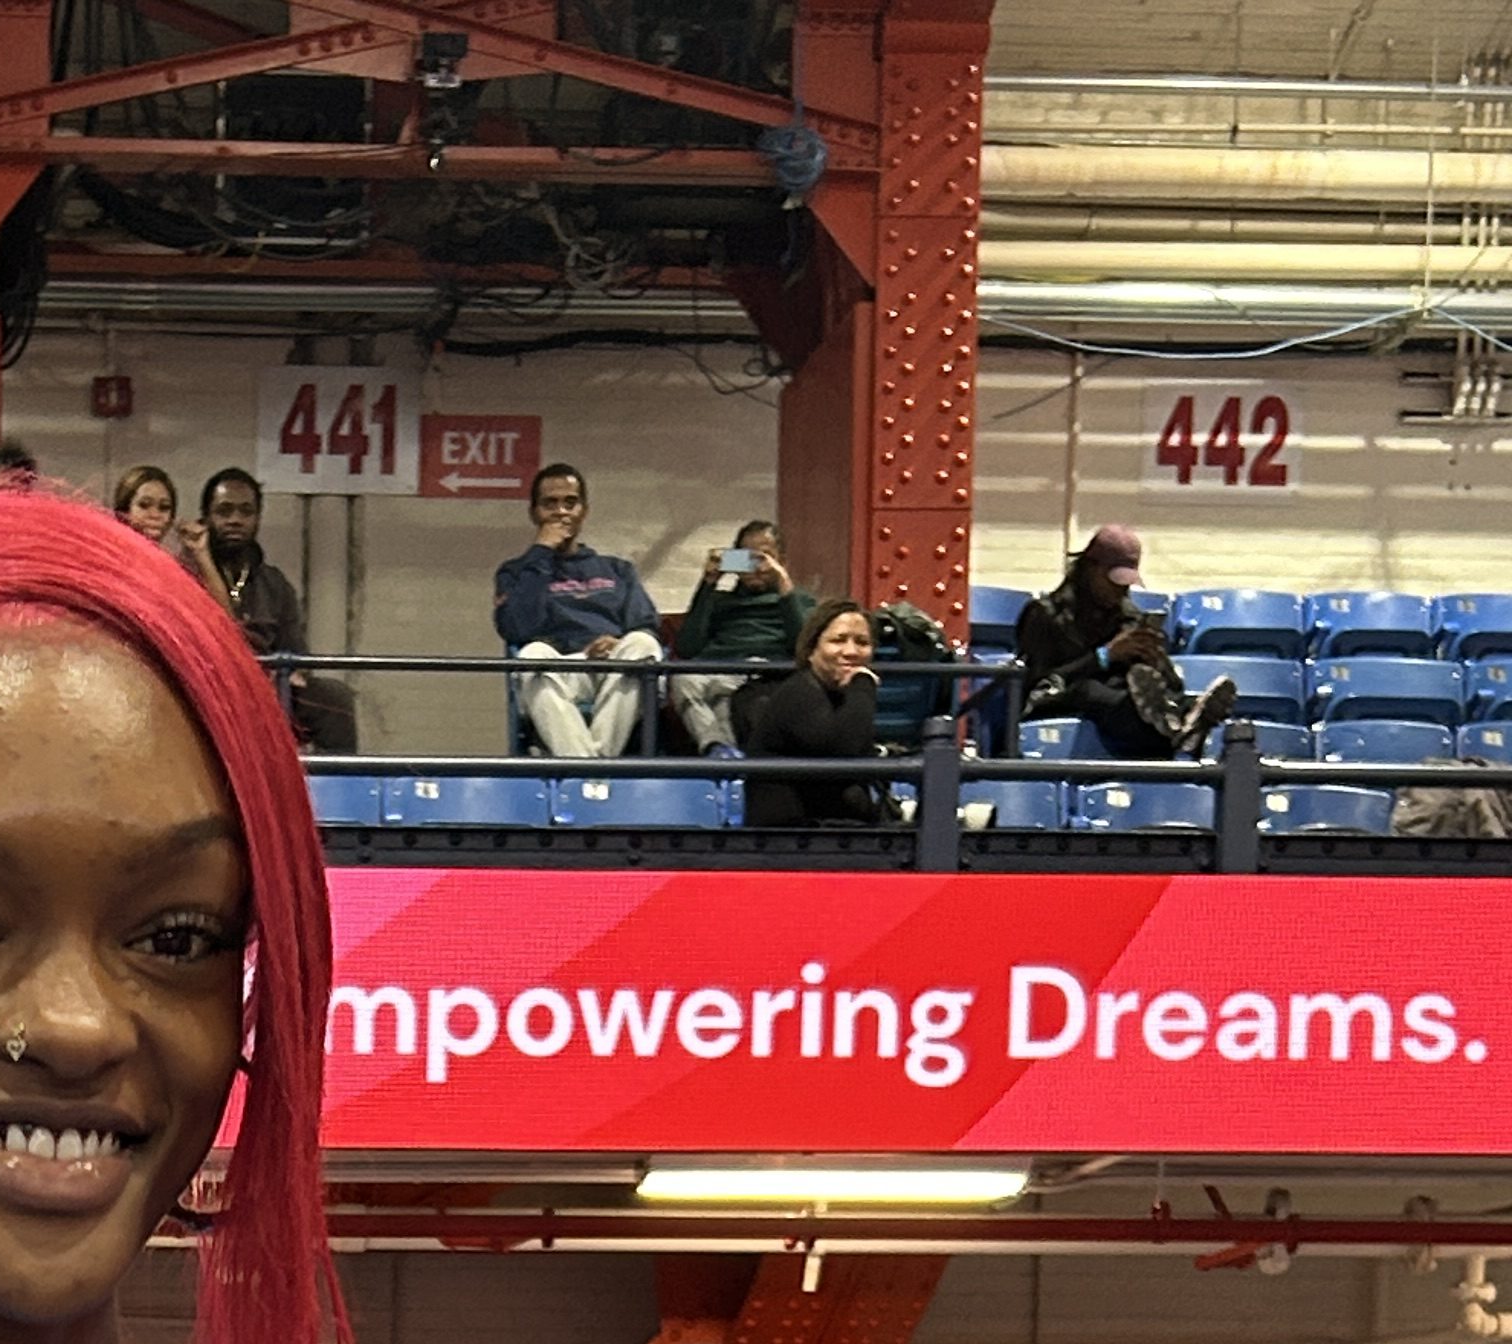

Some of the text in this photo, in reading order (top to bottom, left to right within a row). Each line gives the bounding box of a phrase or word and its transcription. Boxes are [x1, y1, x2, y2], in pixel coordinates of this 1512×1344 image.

[279, 383, 397, 475] 441
[441, 431, 520, 465] EXIT
[1156, 395, 1289, 486] 442
[242, 960, 1488, 1088] mpowering Dreams.
